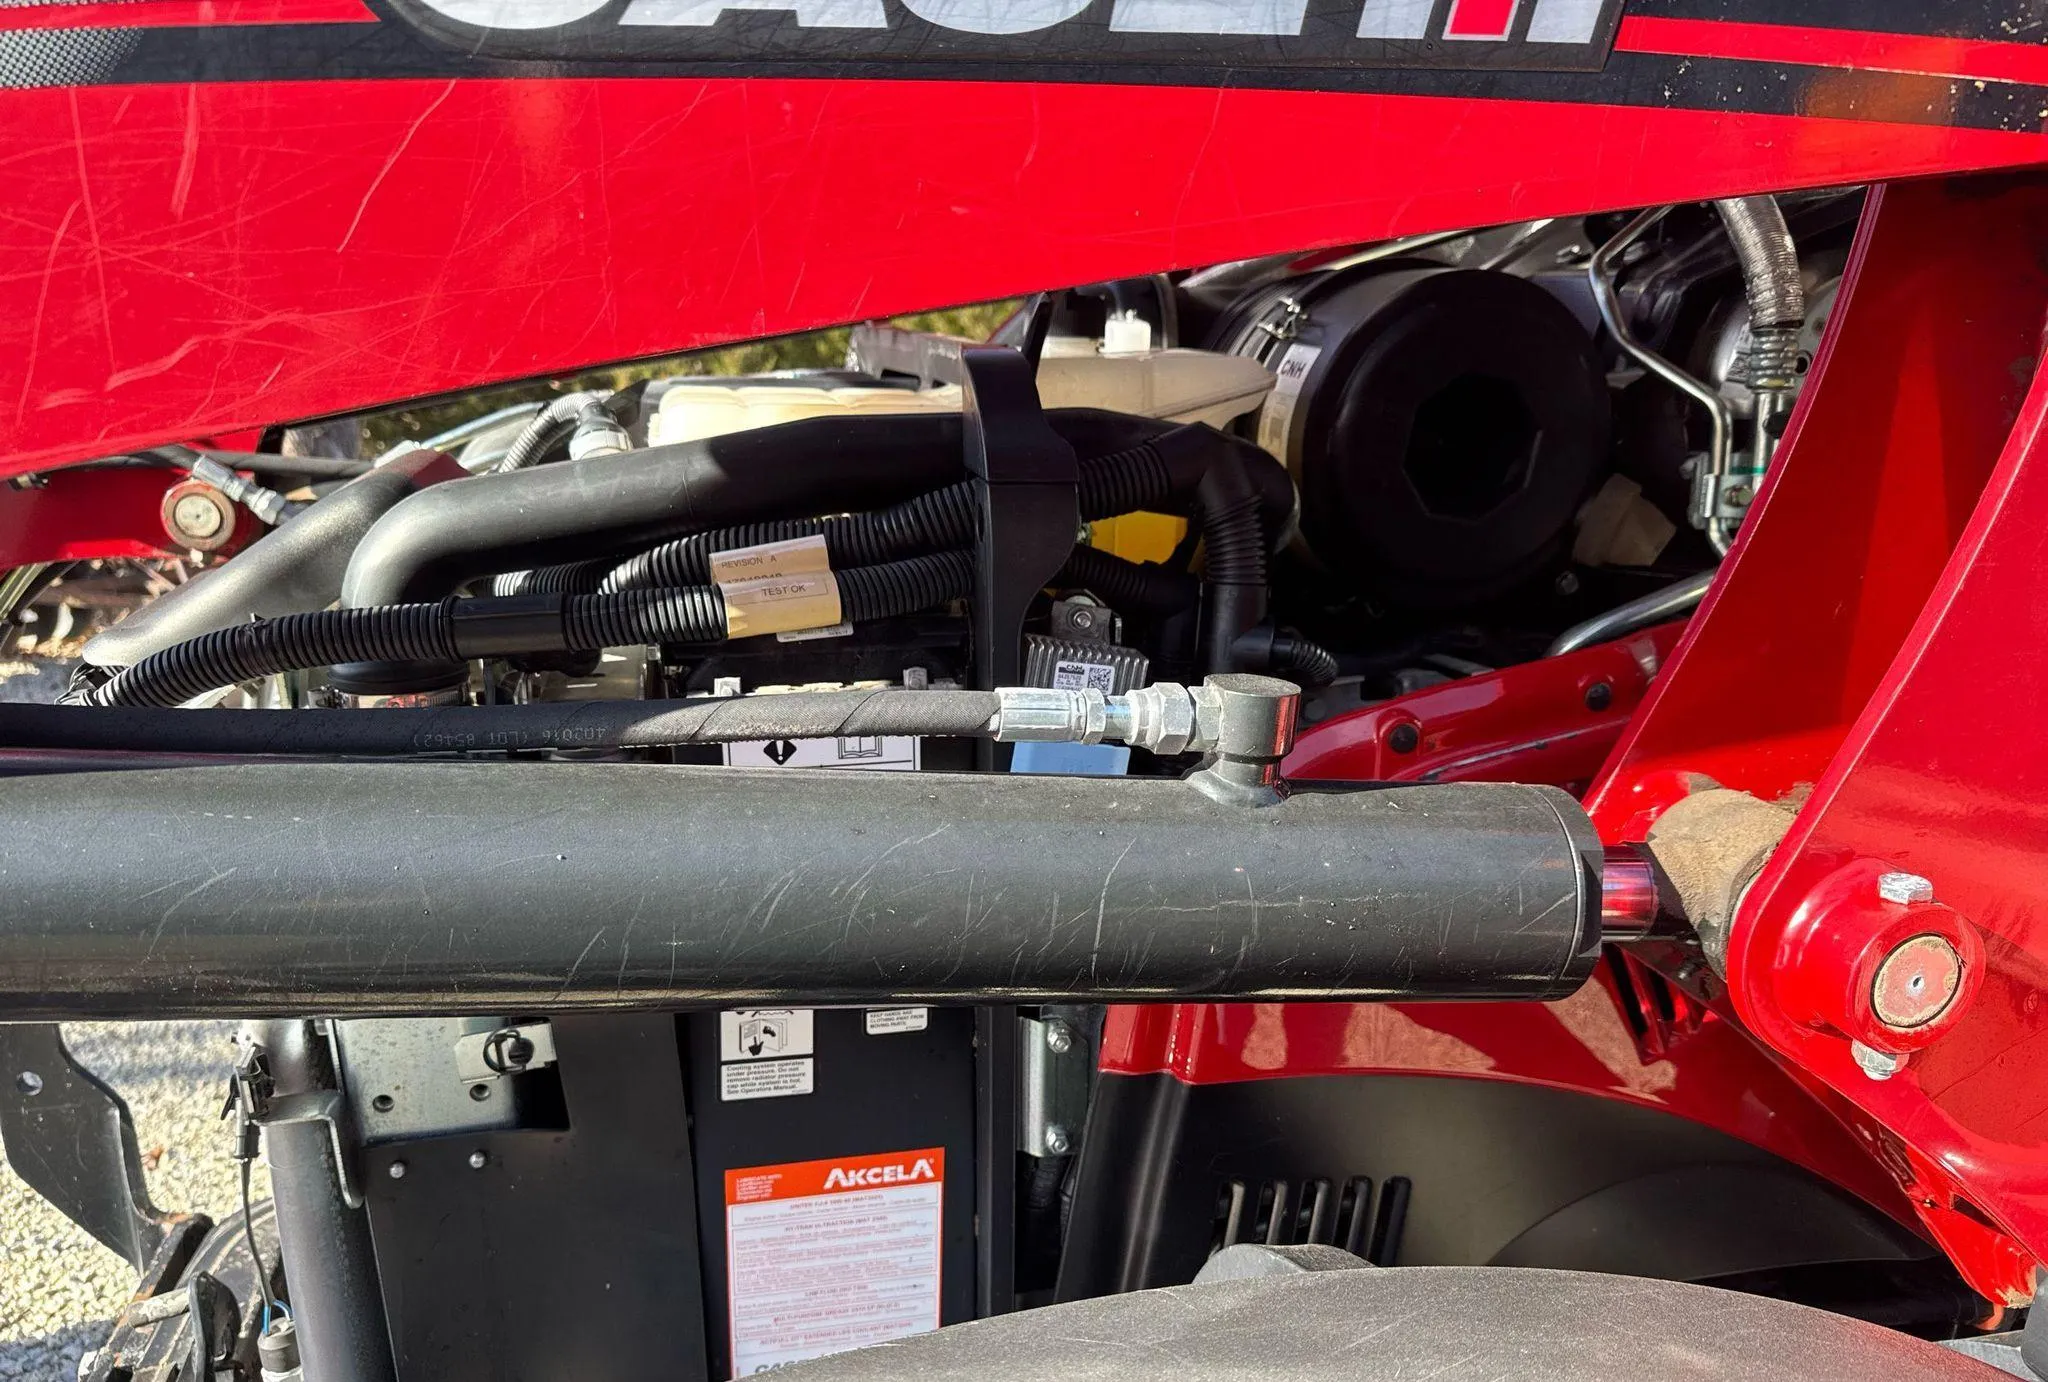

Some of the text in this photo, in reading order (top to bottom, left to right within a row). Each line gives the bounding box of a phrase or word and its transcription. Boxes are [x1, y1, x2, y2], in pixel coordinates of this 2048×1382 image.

[1281, 359, 1307, 379] CNH
[721, 556, 763, 568] REVISION
[761, 584, 806, 597] TEST OK
[778, 1072, 806, 1080] pressure
[758, 1079, 781, 1087] system
[823, 1158, 935, 1189] AKCELA
